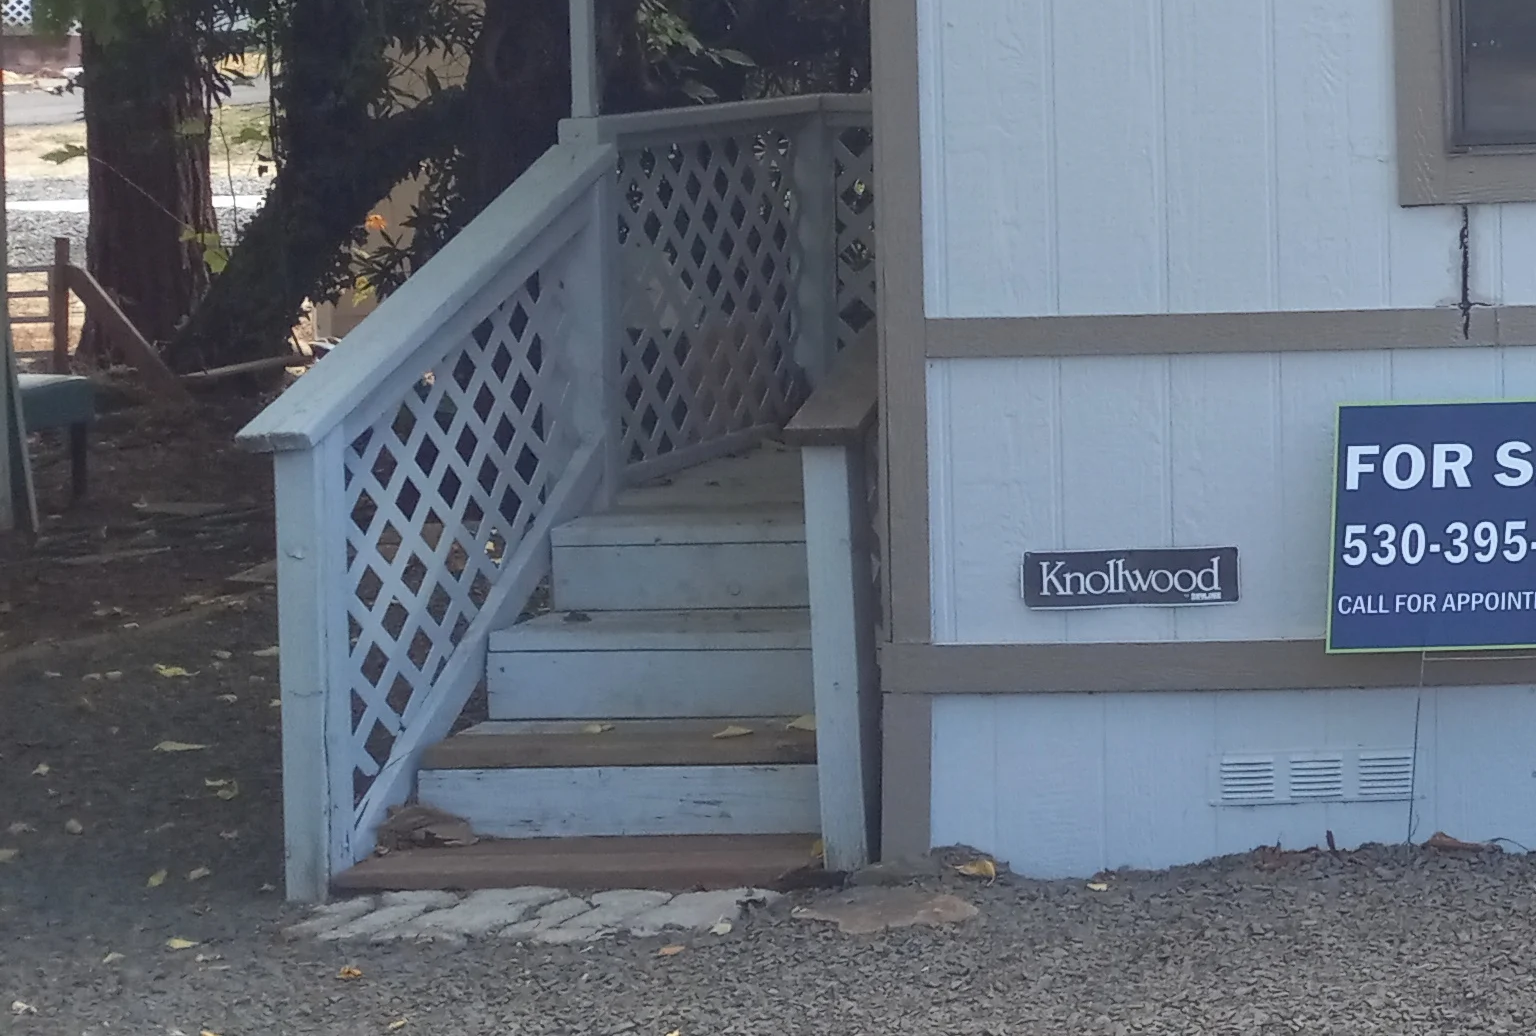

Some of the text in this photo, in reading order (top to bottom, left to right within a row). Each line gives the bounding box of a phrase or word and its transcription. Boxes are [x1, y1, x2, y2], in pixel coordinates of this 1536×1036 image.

[1345, 442, 1474, 490] FOR
[1039, 555, 1222, 596] Knollwood
[1337, 594, 1390, 615] CALL
[1394, 592, 1437, 614] FOR
